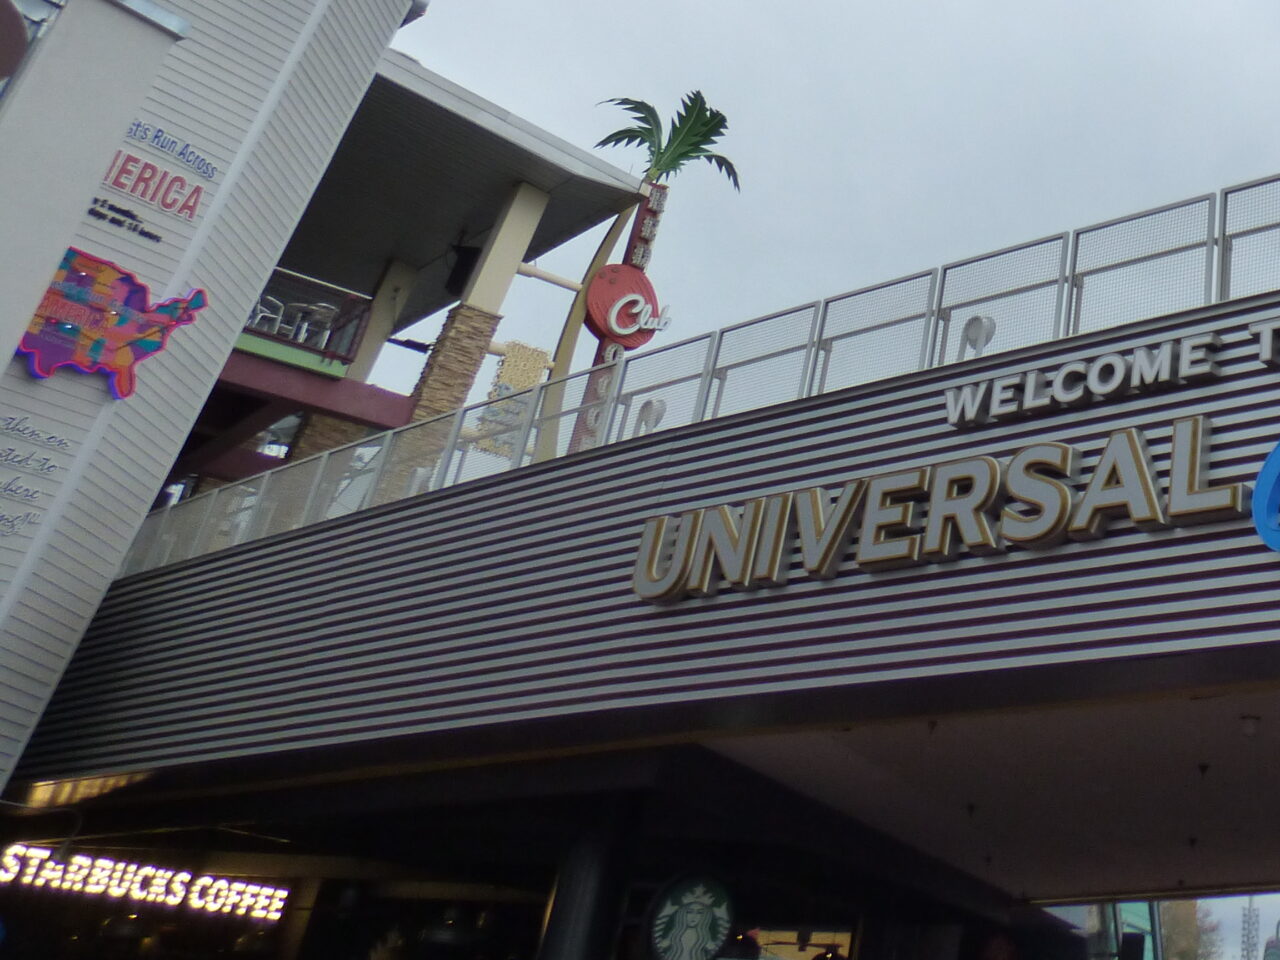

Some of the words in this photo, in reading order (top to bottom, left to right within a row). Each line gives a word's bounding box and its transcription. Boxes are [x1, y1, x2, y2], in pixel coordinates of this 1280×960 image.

[103, 149, 205, 219] ERICA
[151, 128, 178, 153] Run
[177, 143, 218, 179] Across
[607, 293, 671, 336] Club
[944, 331, 1222, 429] WELCOME
[0, 476, 41, 500] here
[630, 414, 1254, 606] UNIVERSAL
[0, 844, 193, 906] STARBUCKS
[187, 875, 289, 921] COFFEE
